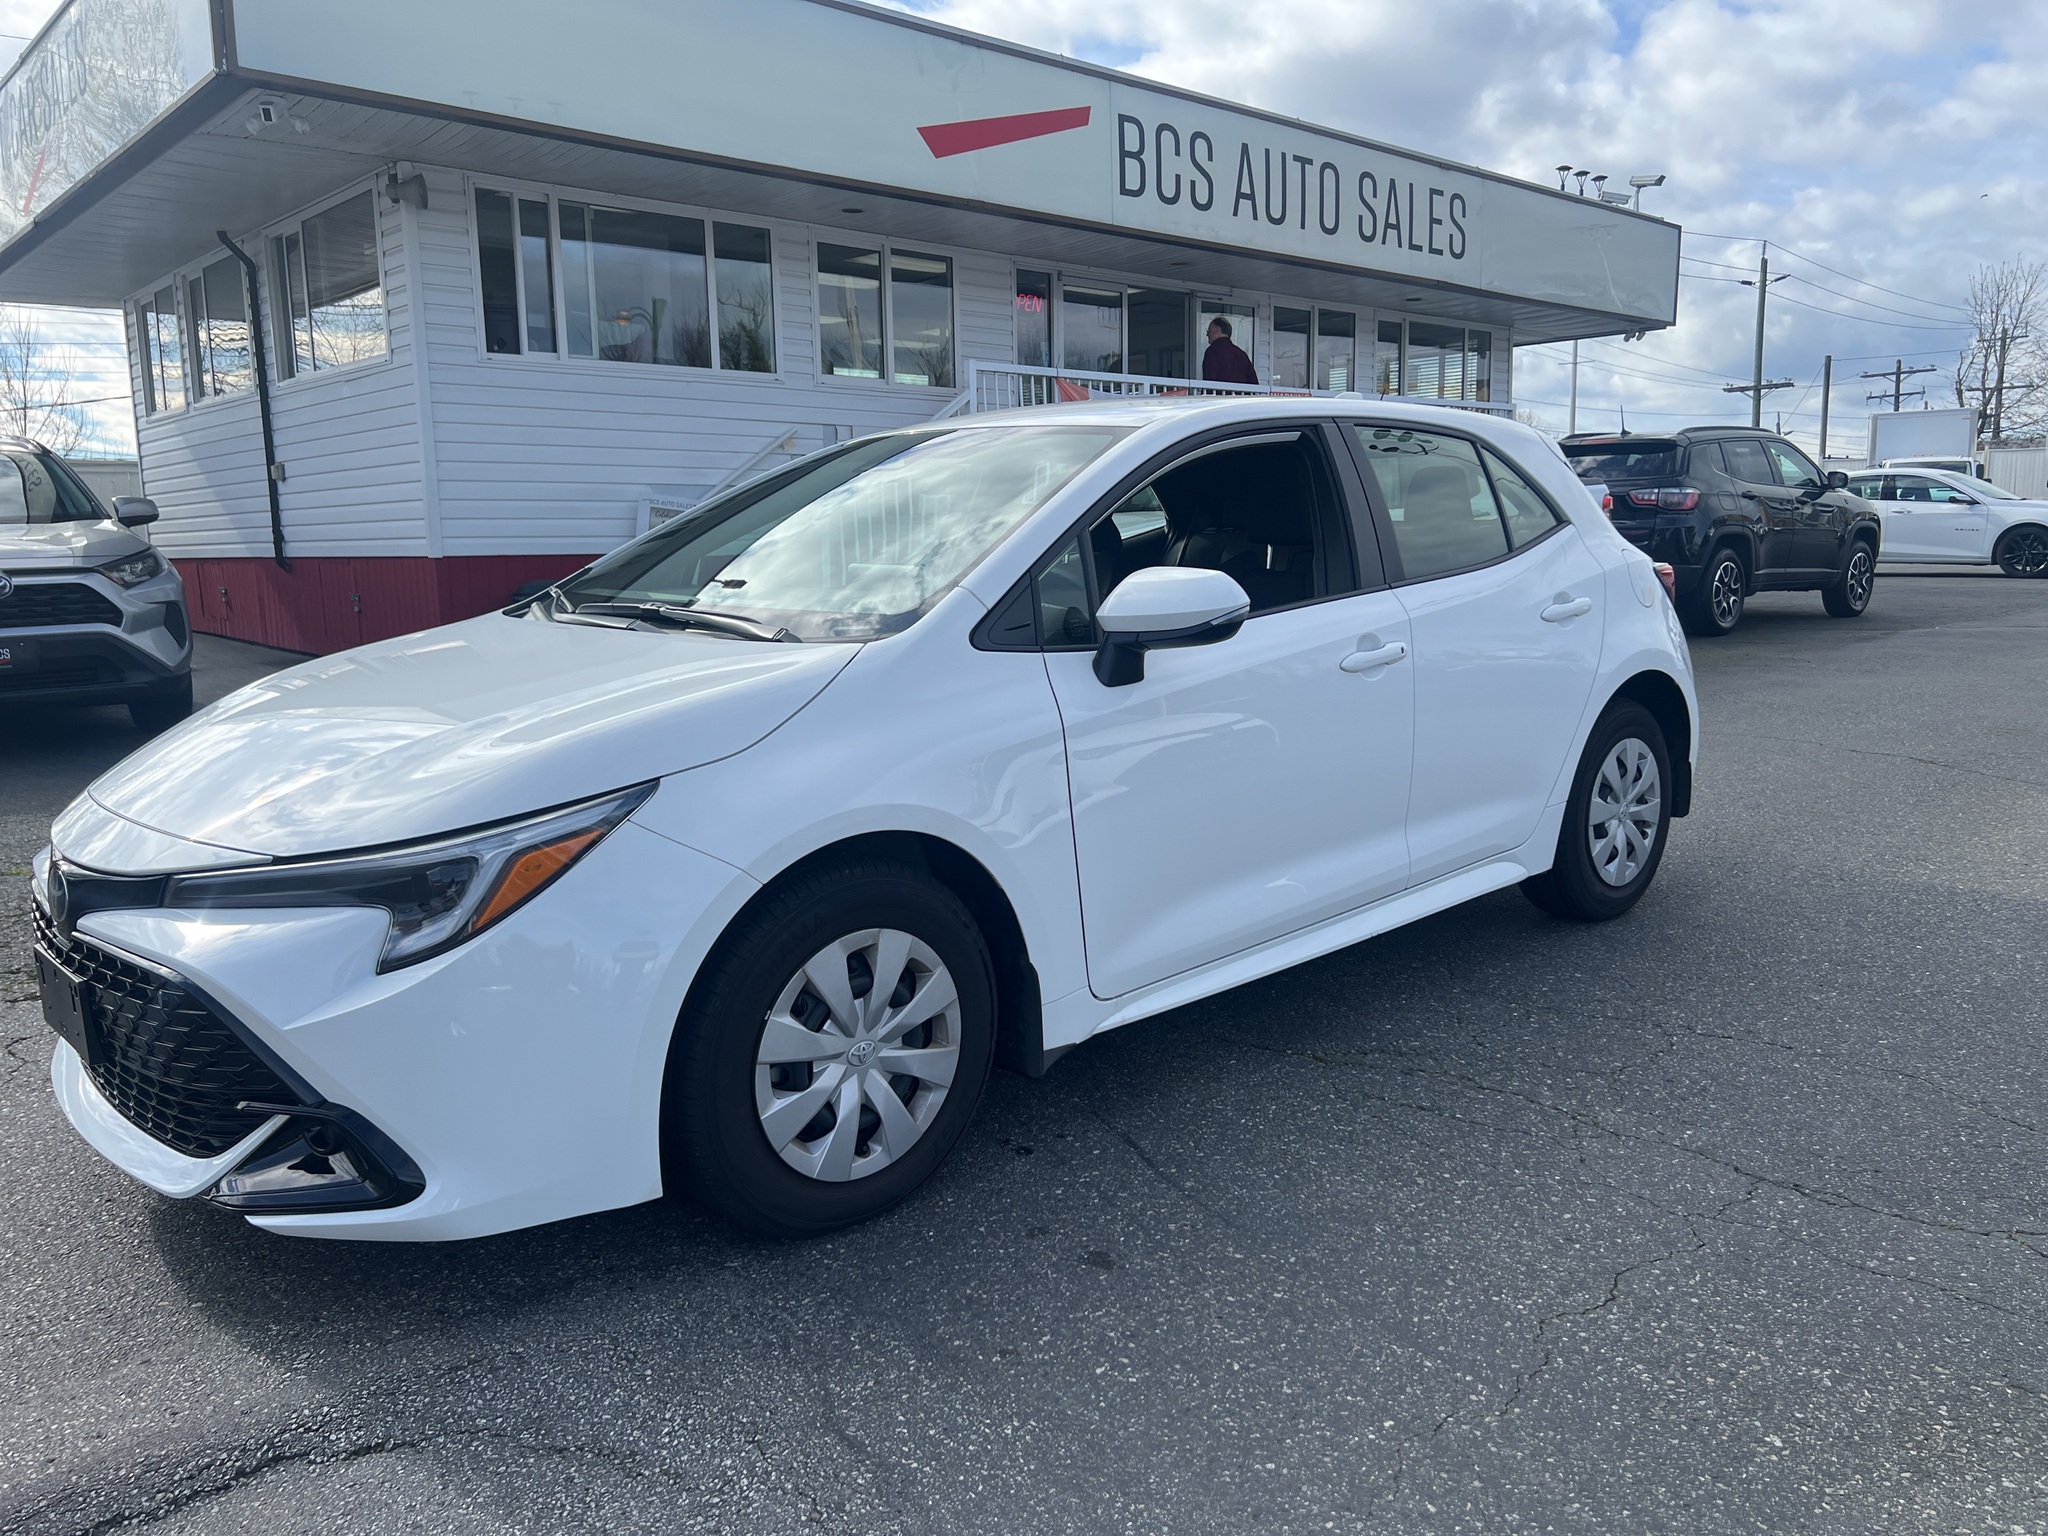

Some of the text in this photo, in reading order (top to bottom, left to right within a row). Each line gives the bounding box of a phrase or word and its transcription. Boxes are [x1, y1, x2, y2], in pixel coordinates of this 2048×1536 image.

[41, 18, 87, 132] SALES
[1118, 113, 1466, 260] BCS AUTO SALES
[1017, 293, 1043, 312] PEN
[0, 648, 11, 659] CS
